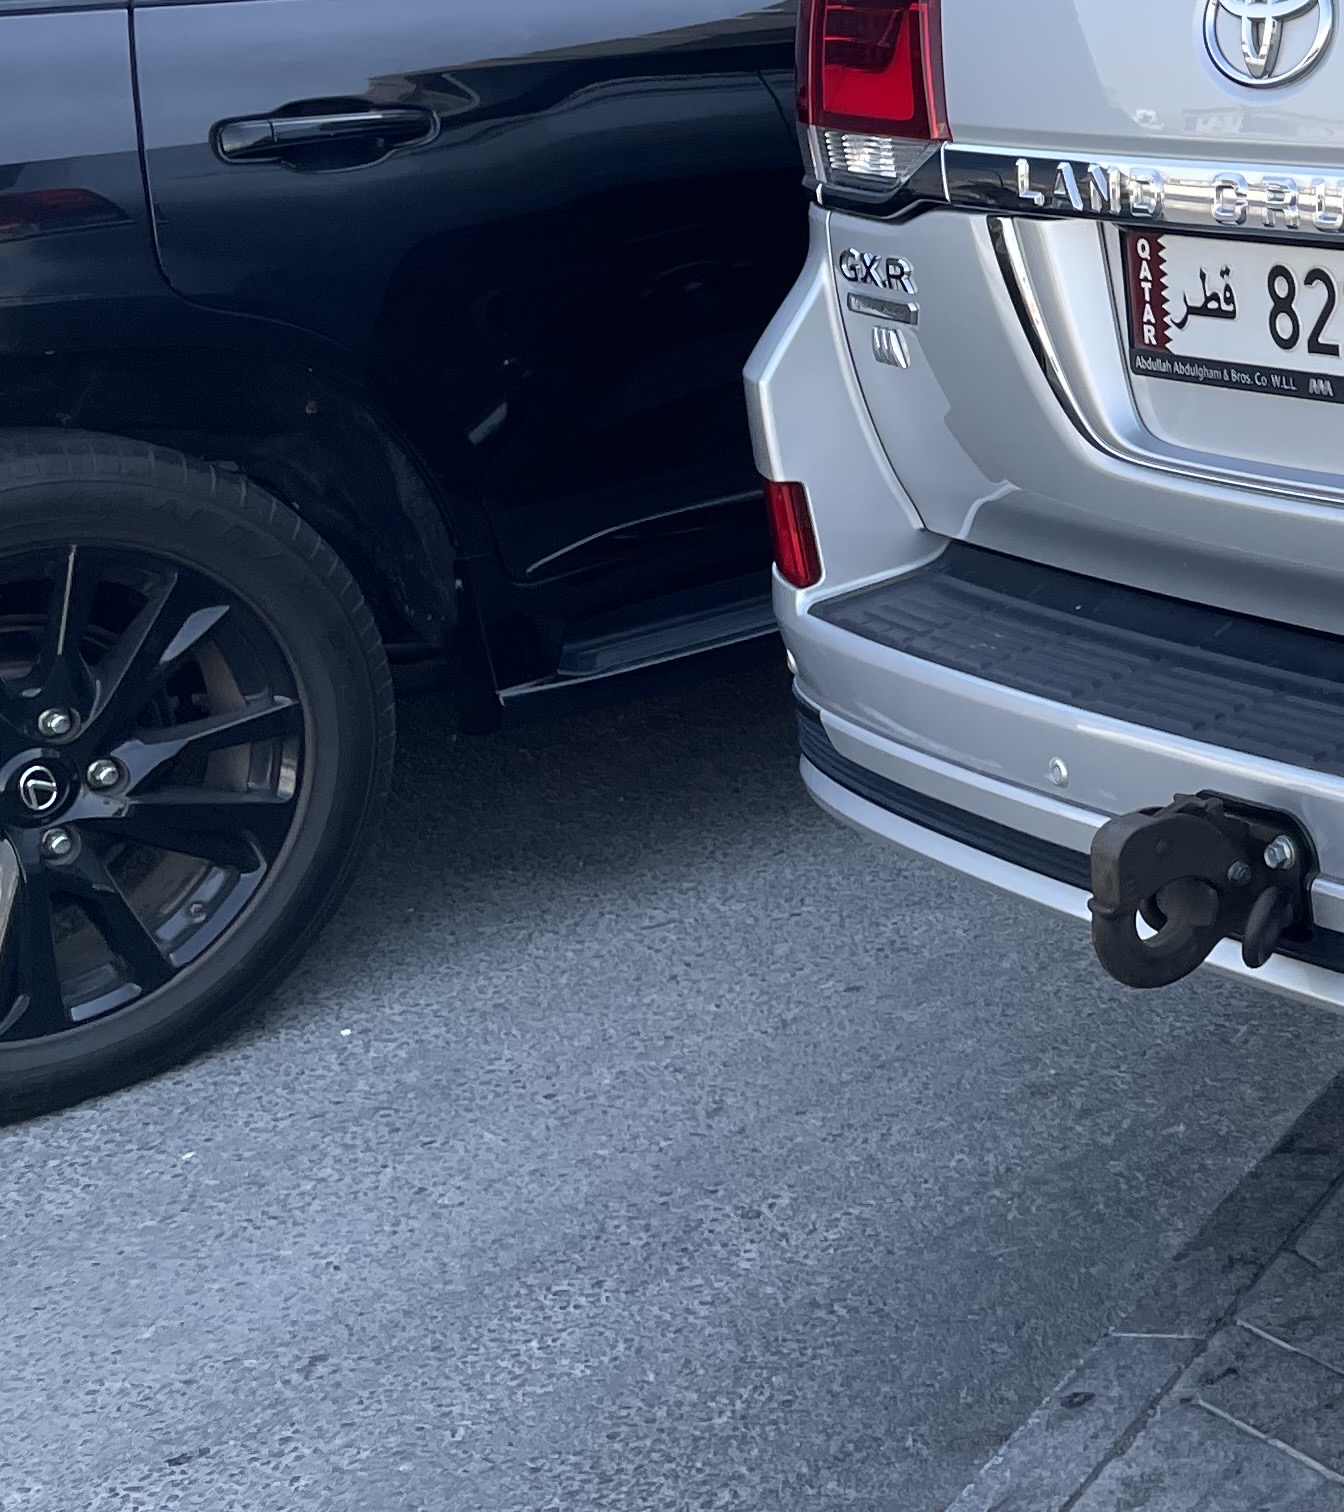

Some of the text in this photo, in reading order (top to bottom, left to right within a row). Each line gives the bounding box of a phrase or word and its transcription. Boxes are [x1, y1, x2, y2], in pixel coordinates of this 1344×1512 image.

[1013, 157, 1165, 222] LAND
[839, 247, 919, 295] GXR
[1136, 237, 1158, 347] QATAR
[1170, 263, 1238, 330] قطر
[1135, 355, 1172, 374] Abdullah
[1173, 361, 1222, 382] Abdulghani
[1223, 370, 1230, 382] &
